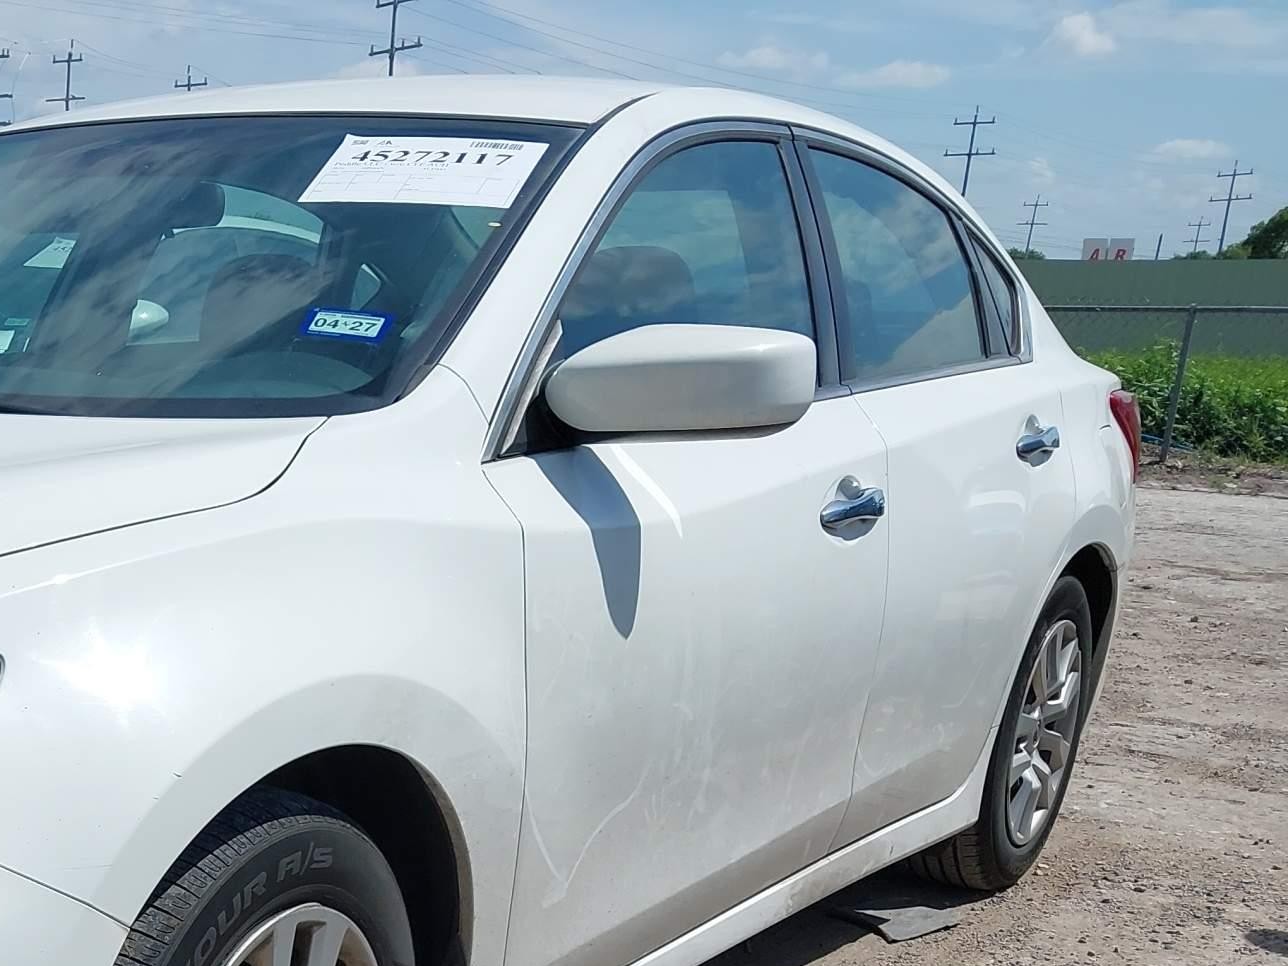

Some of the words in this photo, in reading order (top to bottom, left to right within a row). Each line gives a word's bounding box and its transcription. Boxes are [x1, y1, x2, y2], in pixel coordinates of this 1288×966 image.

[350, 150, 514, 166] 45272117
[349, 321, 378, 332] 27
[276, 841, 334, 883] A/S
